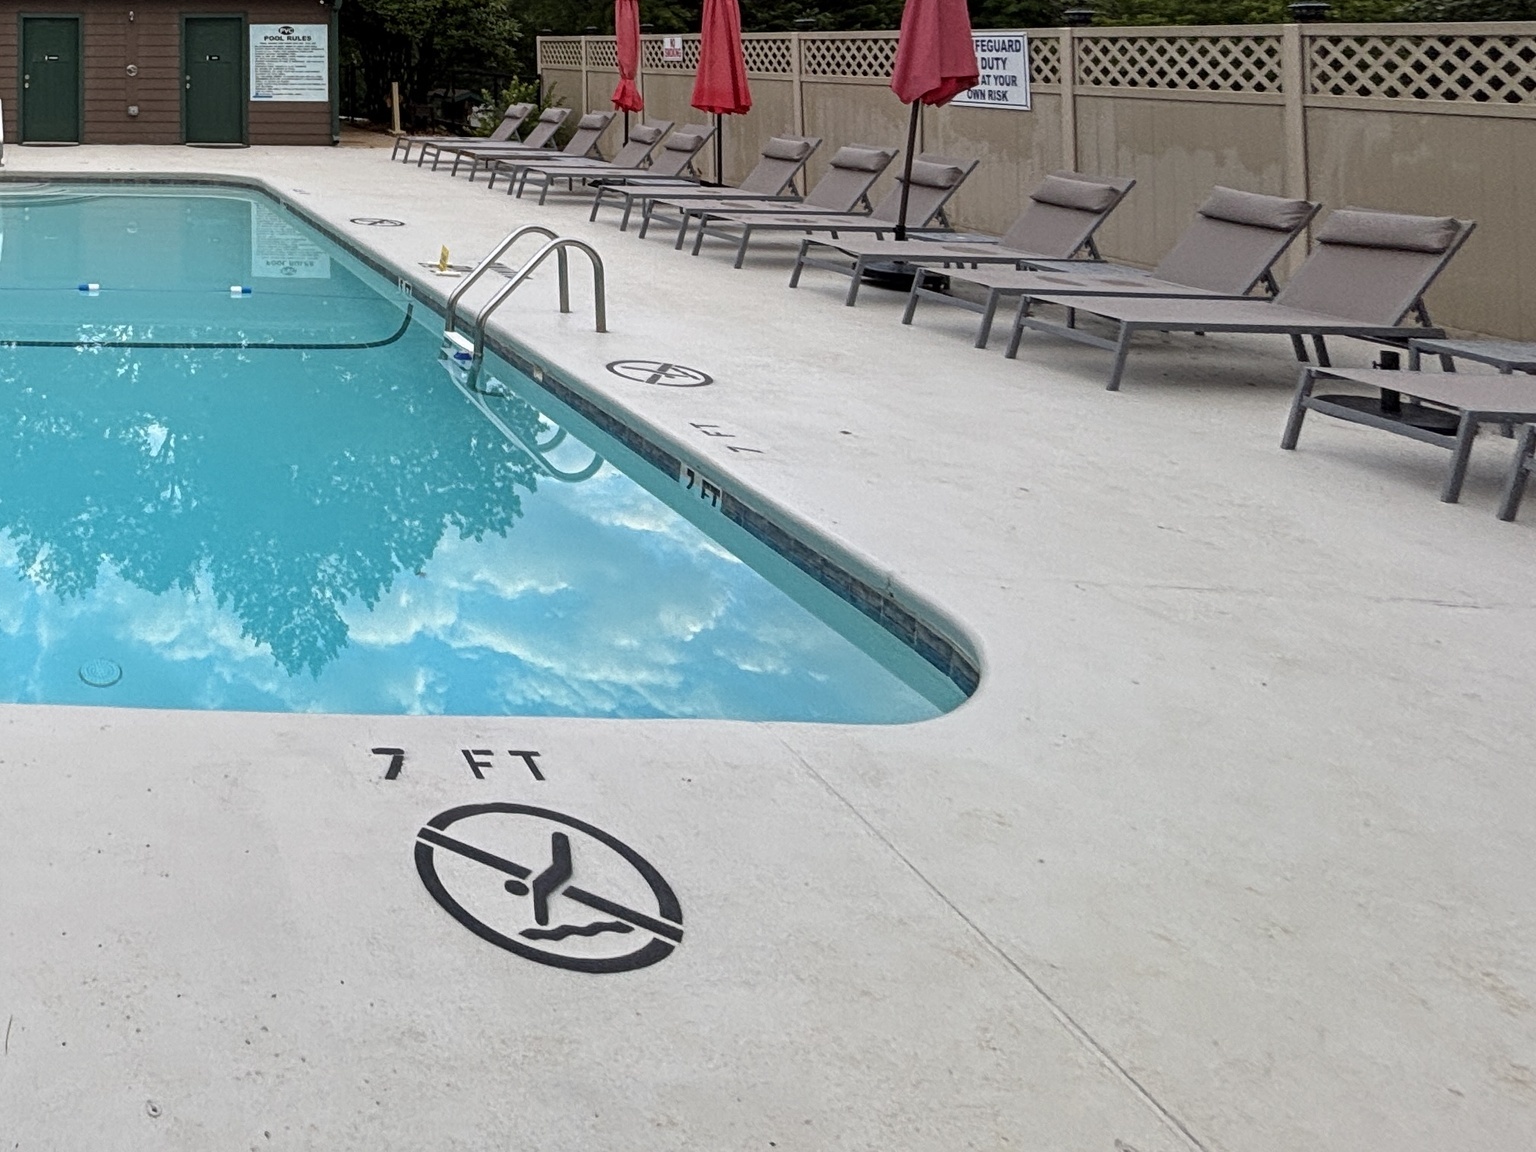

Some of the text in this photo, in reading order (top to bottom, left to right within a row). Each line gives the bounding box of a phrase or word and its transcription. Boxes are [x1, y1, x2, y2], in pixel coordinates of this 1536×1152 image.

[975, 39, 1021, 53] FEGUARD
[981, 57, 1007, 70] DUTY
[981, 74, 1018, 87] AT YOUR
[967, 89, 1009, 102] OWN RISK
[686, 468, 721, 508] 7 FT
[371, 747, 546, 781] 7 FT
